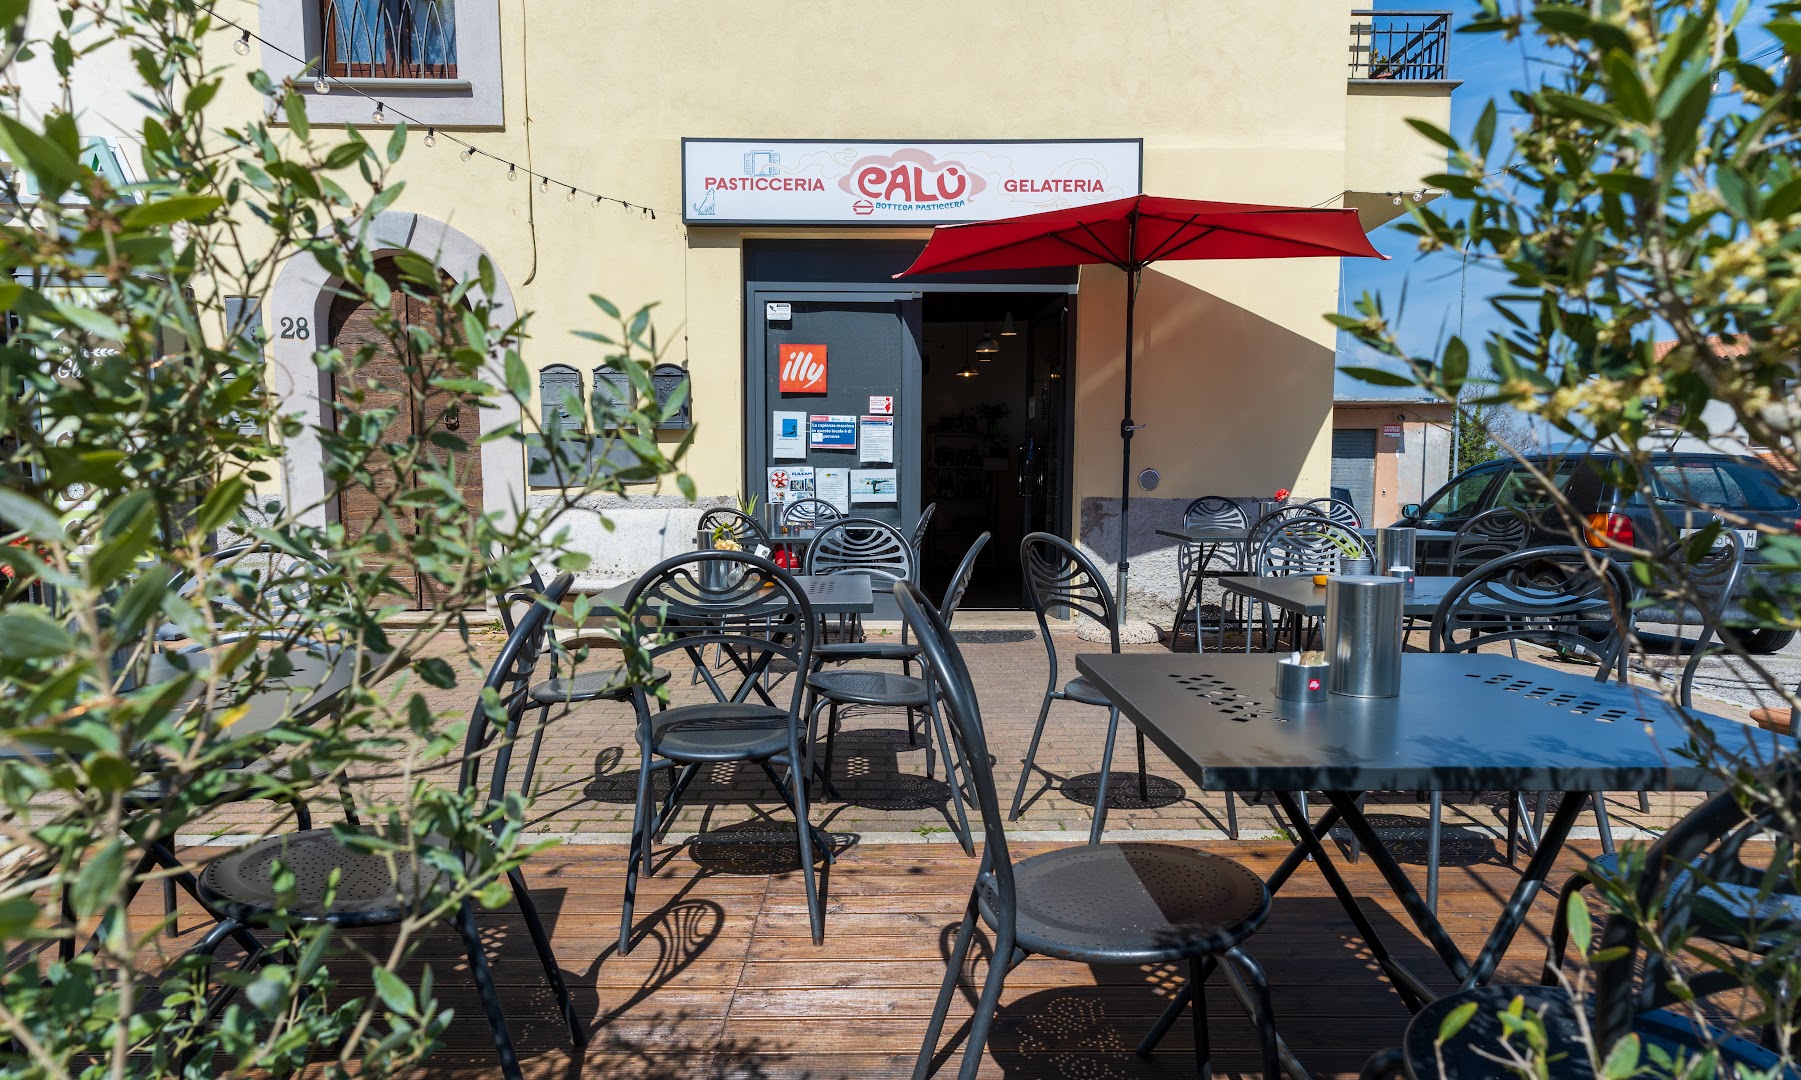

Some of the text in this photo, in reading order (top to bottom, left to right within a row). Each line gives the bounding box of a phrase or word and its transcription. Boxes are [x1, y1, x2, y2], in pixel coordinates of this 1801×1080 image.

[704, 177, 826, 192] PASTICCERIA
[1003, 179, 1105, 193] GELATERIA
[875, 200, 965, 211] BOTTEGA PASTICCERA
[280, 316, 310, 340] 28
[782, 350, 825, 389] illy
